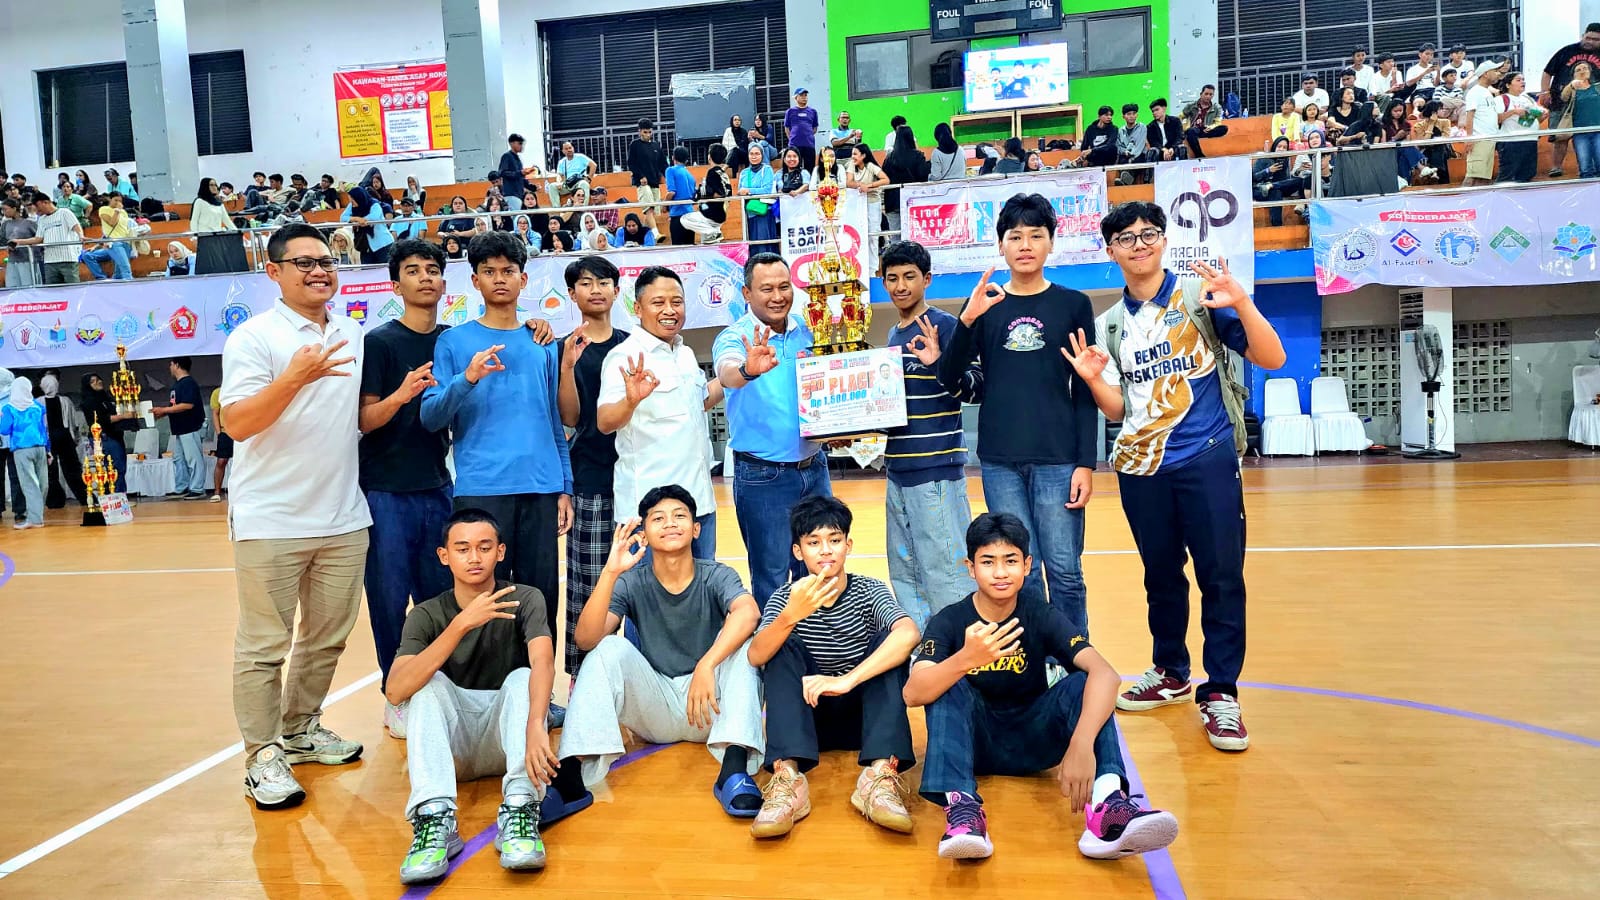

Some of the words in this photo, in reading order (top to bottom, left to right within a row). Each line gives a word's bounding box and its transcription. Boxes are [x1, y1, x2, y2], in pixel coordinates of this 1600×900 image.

[1030, 0, 1053, 8] FOUL
[937, 9, 960, 18] FOUL
[1405, 213, 1469, 221] SEDERAJAT
[17, 303, 62, 312] SEDERAJAT
[1134, 340, 1172, 366] BENTO
[829, 370, 876, 396] PLACE
[824, 389, 867, 405] 1.500.000
